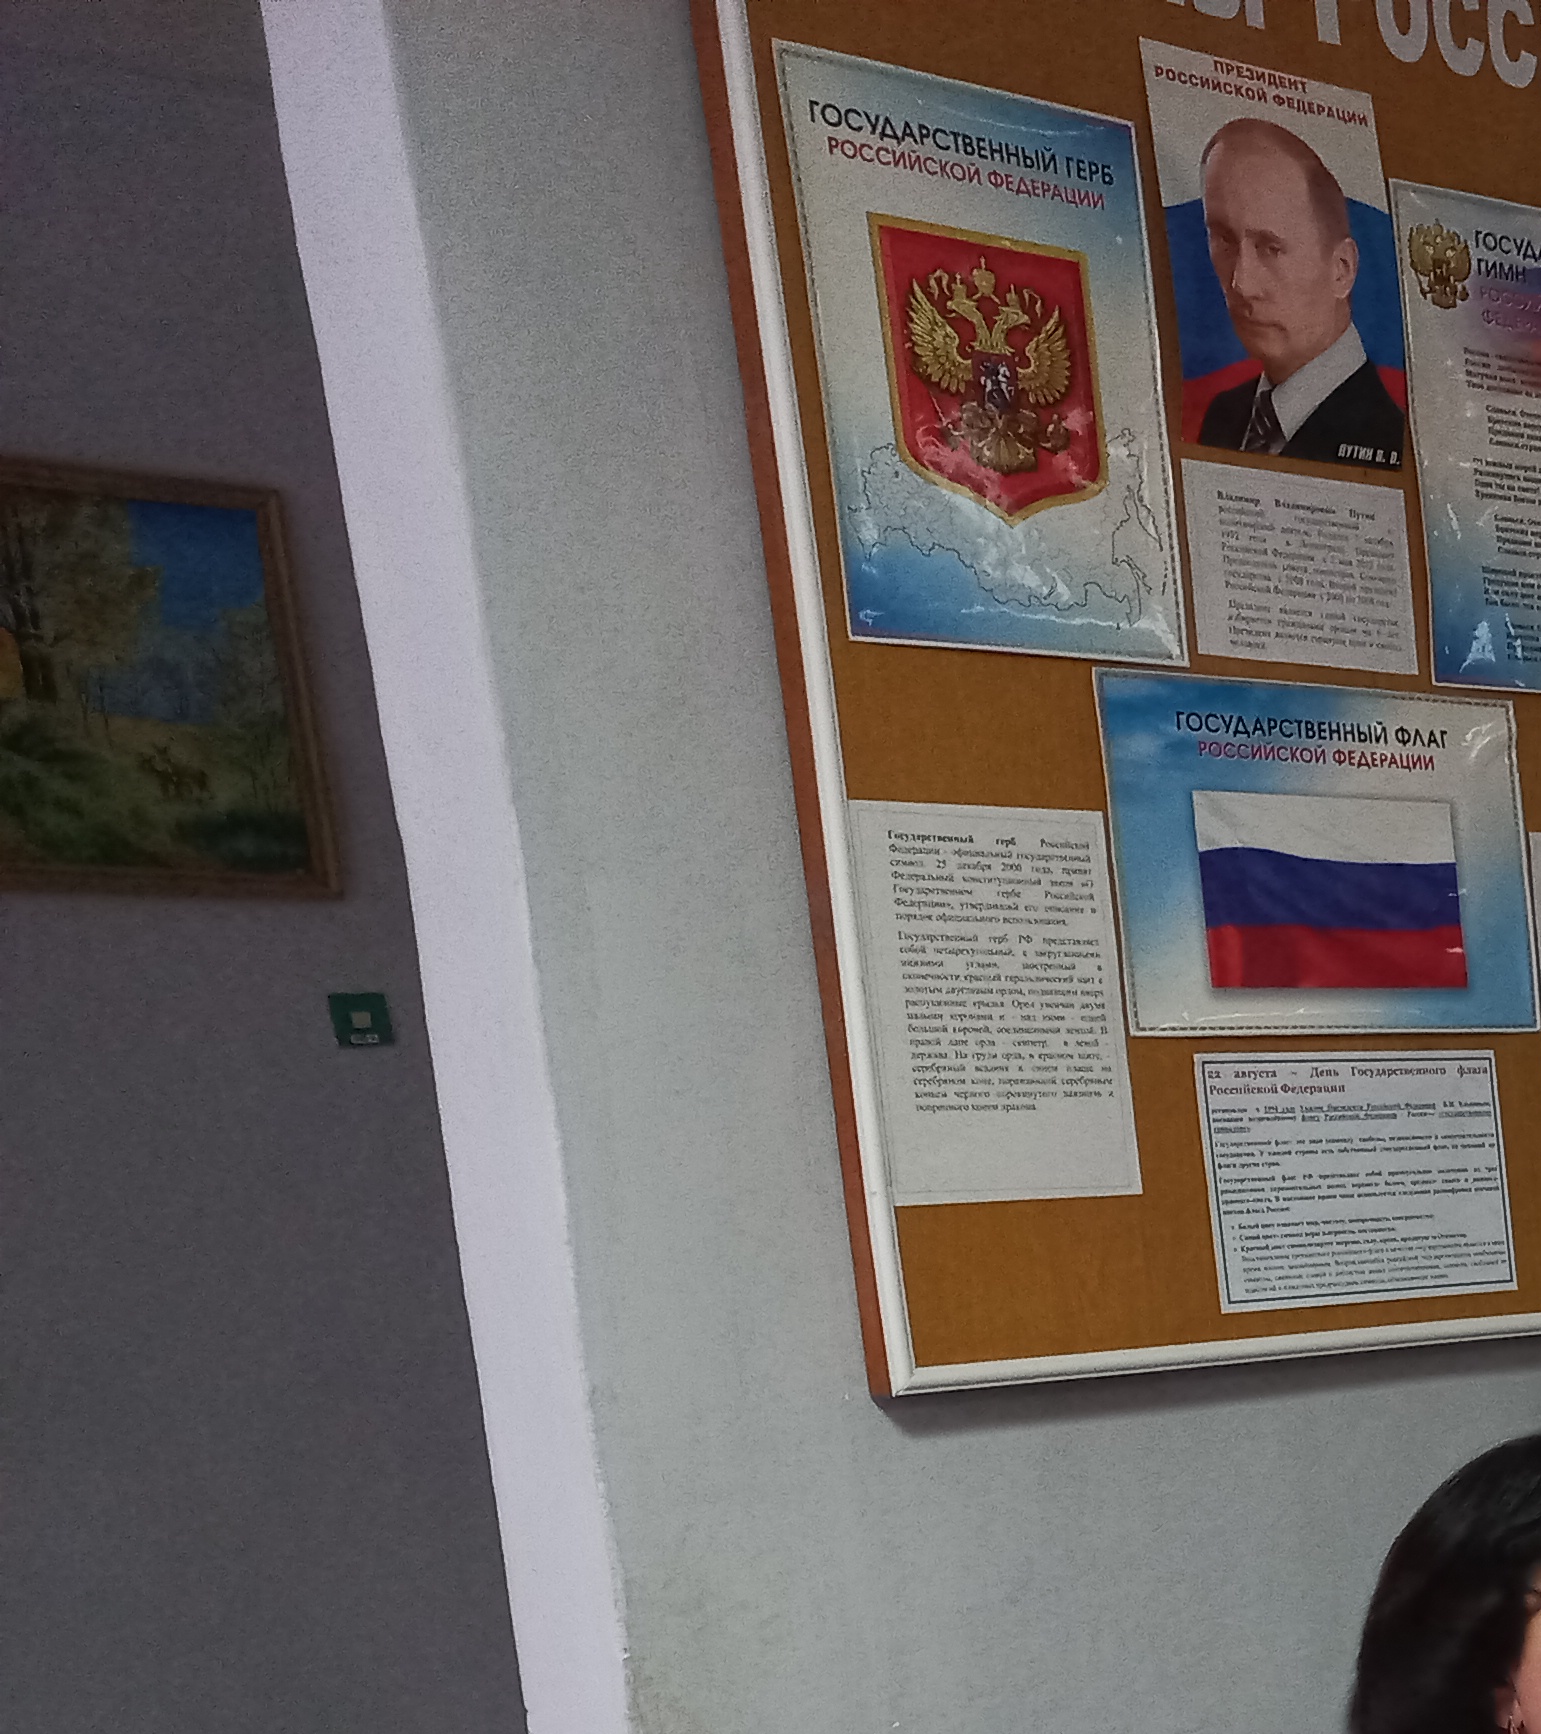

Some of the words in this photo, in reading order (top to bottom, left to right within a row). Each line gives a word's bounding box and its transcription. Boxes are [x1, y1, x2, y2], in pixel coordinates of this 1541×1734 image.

[1214, 60, 1307, 93] ПРЕЗИДЕНТ
[1154, 65, 1268, 104] РОССИЙСКОЙ
[1272, 94, 1369, 127] ФЕДЕРАЦИИ
[808, 99, 1059, 175] ГОСУДАРСТВЕННЫЙ
[1065, 156, 1114, 186] ГЕРБ
[827, 136, 982, 186] РОССИЙСКОЙ
[987, 170, 1106, 211] ФЕДЕРАЦИИ
[1477, 257, 1527, 284] ГИМН
[1338, 443, 1374, 461] ПУТИН
[1175, 711, 1388, 745] ГОСУДАРСТВЕННЫЙ
[1395, 725, 1448, 750] ФЛАГ
[1197, 740, 1327, 765] РОССИЙСКОЙ
[1332, 748, 1435, 772] ФЕДЕРАЦИИ
[887, 829, 974, 845] Государственный
[1208, 1084, 1278, 1096] Российской
[1280, 1082, 1346, 1096] Федерации
[1233, 1069, 1277, 1082] августа
[1310, 1066, 1340, 1079] День
[1350, 1066, 1447, 1079] Государственного
[1457, 1065, 1488, 1078] флага
